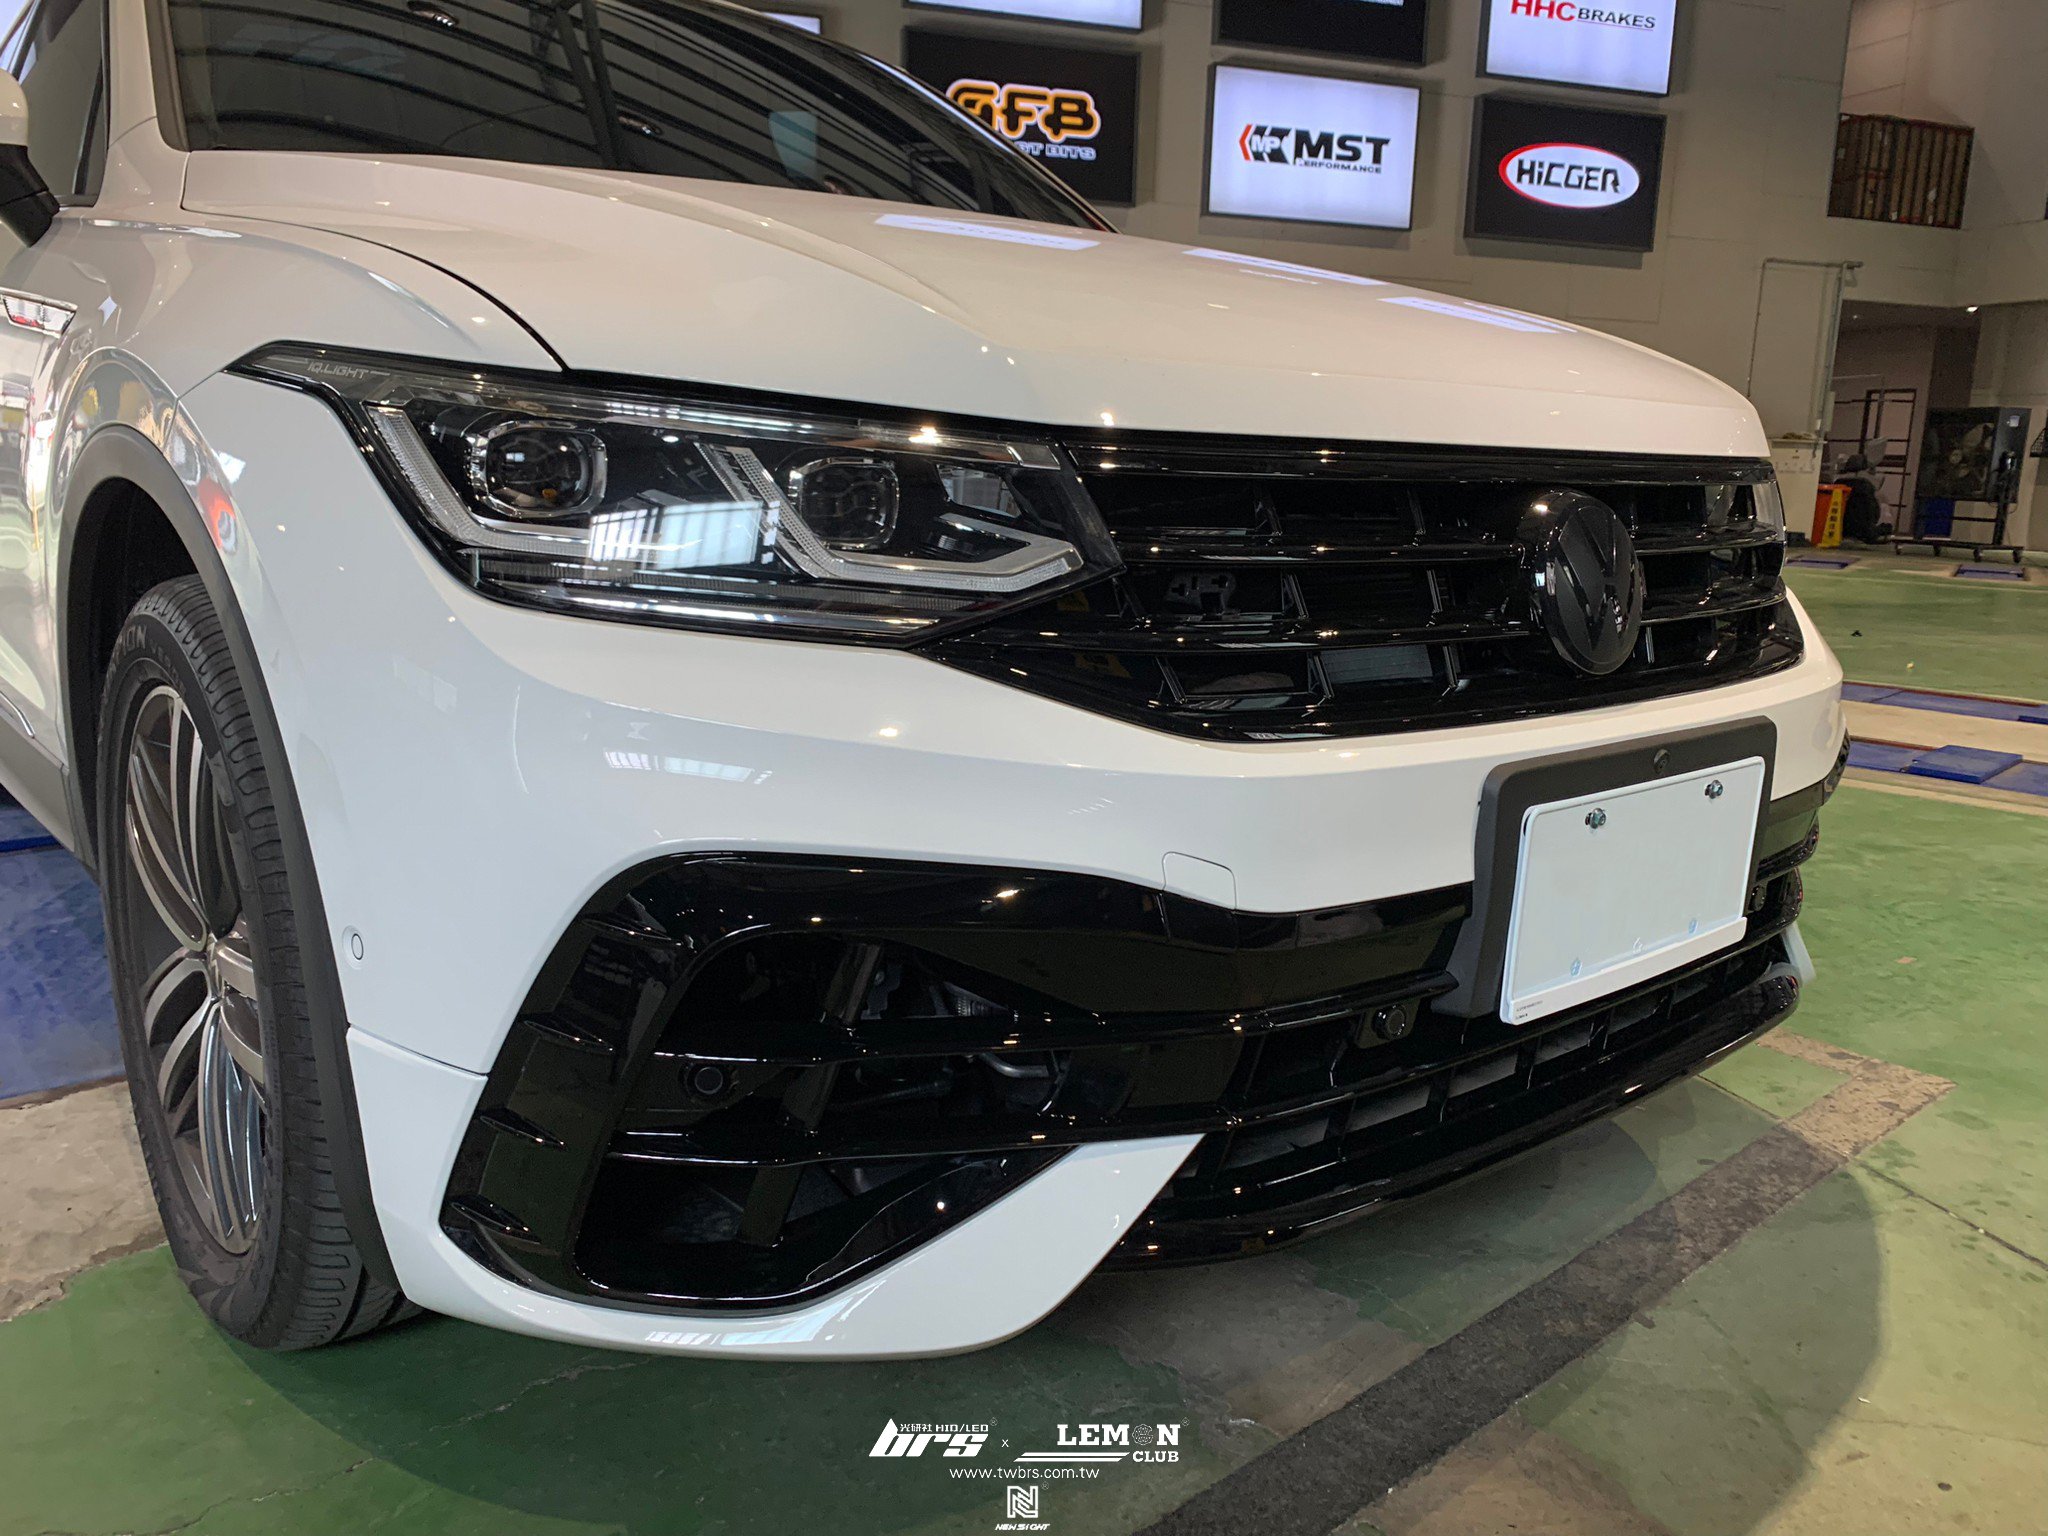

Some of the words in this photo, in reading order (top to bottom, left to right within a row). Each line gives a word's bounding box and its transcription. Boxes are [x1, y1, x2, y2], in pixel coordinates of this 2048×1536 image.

[1510, 0, 1577, 22] HHC
[1577, 7, 1656, 30] BRAKES
[1045, 143, 1097, 161] BITS
[1294, 127, 1392, 165] MST
